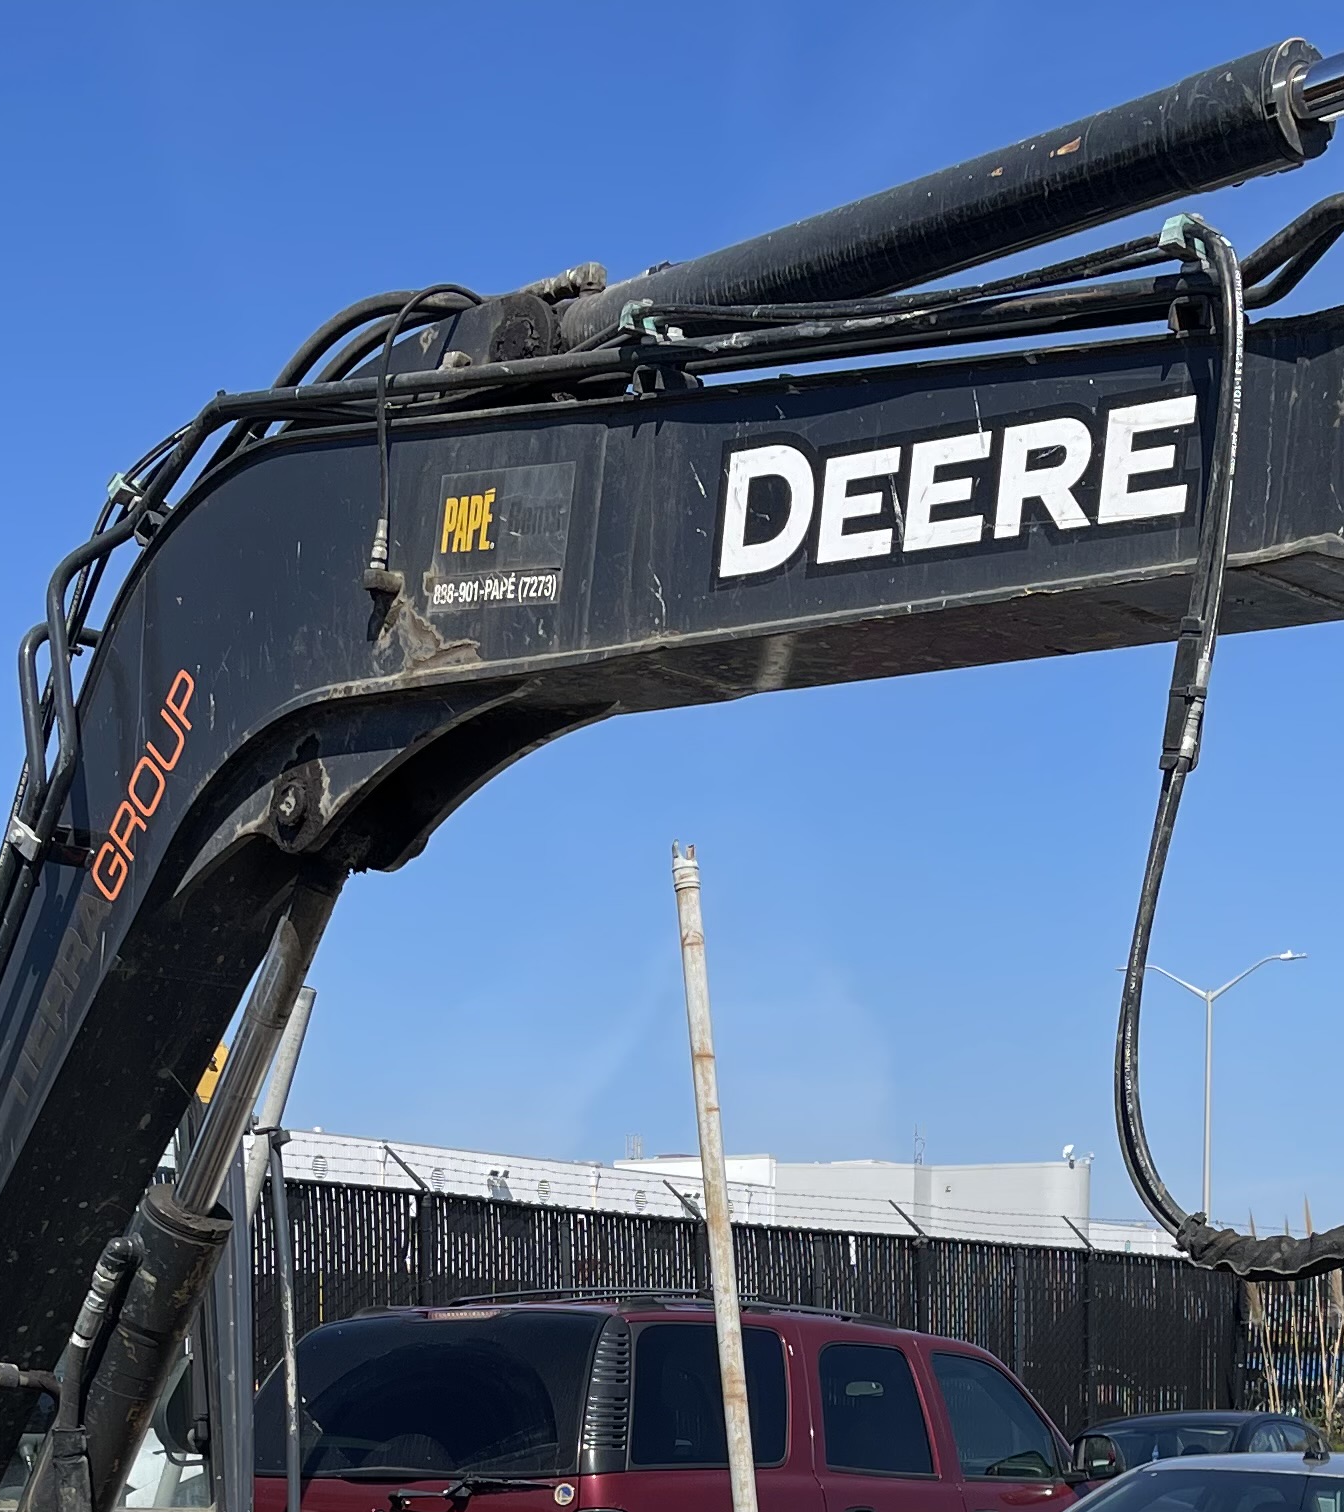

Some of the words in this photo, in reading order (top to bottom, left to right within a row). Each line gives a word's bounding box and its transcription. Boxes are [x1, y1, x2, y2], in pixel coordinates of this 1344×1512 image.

[440, 487, 497, 554] PAPÉ
[718, 393, 1198, 579] DEERE
[518, 574, 557, 603] (7273)
[91, 668, 196, 902] GROUP
